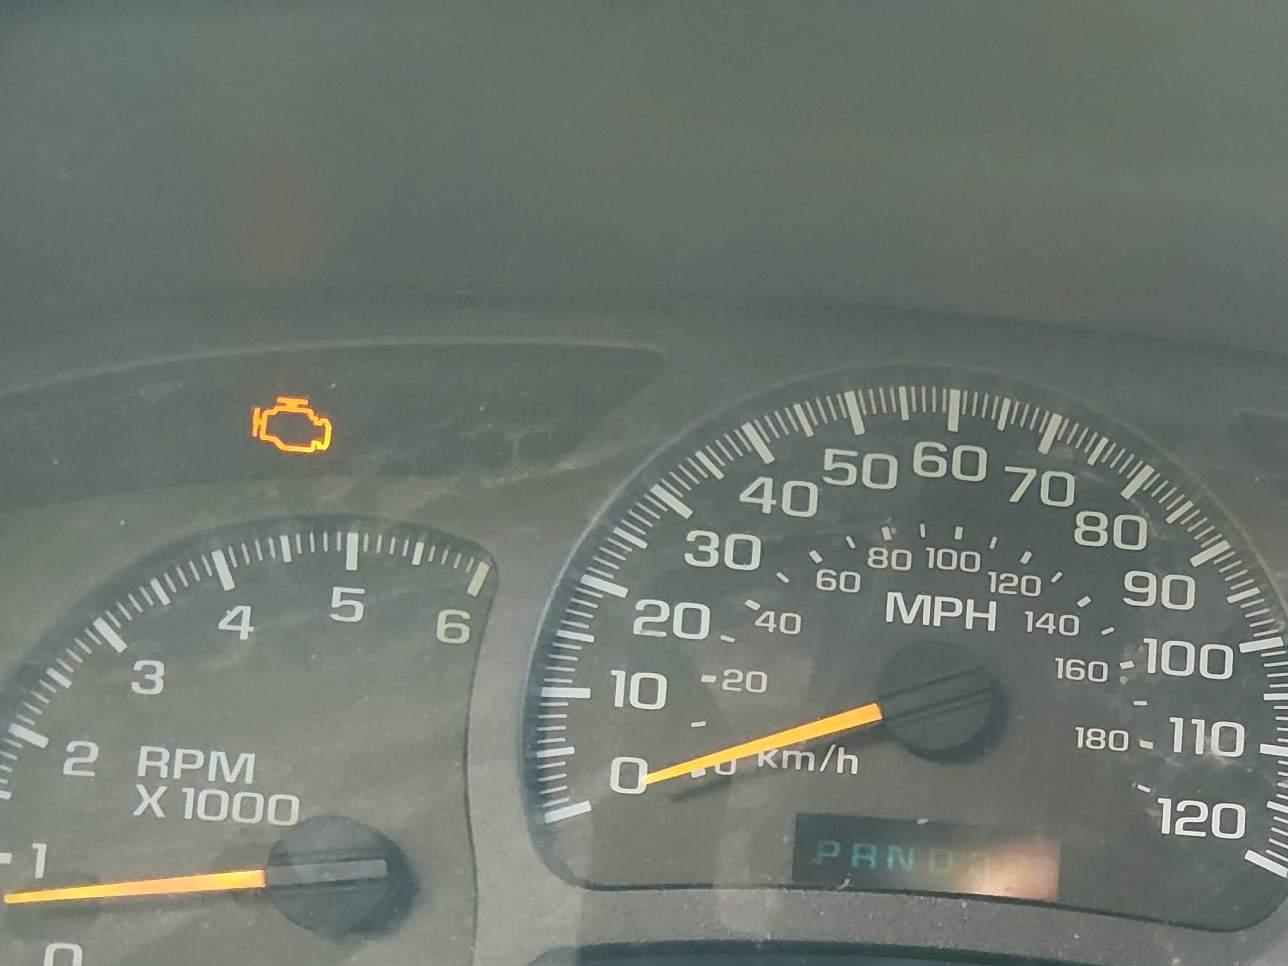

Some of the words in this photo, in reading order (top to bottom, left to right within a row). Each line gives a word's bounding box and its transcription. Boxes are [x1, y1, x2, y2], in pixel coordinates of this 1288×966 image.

[822, 448, 898, 490] 50
[912, 441, 988, 482] 60
[739, 476, 819, 518] 40
[1004, 465, 1076, 508] 70
[1074, 510, 1148, 551] 80
[684, 529, 762, 571] 30
[867, 547, 913, 571] 80
[925, 546, 981, 573] 100
[816, 568, 861, 593] 60
[988, 571, 1042, 597] 120
[1122, 570, 1196, 611] 90
[218, 605, 255, 641] 4
[329, 586, 366, 623] 5
[632, 598, 711, 640] 20
[754, 610, 802, 635] 40
[885, 591, 997, 632] MPH
[1024, 610, 1080, 636] 140
[436, 609, 471, 644] 6
[131, 659, 165, 695] 3
[1054, 657, 1109, 683] 160
[1143, 637, 1234, 680] 100
[610, 669, 668, 710] 10
[722, 668, 768, 693] 20
[1075, 726, 1129, 752] 180
[1169, 716, 1245, 758] 110
[62, 740, 99, 777] 2
[137, 745, 256, 785] RPM
[609, 756, 649, 795] 0
[757, 743, 859, 775] km/h
[133, 783, 169, 818] X
[181, 787, 300, 826] 1000
[1157, 797, 1246, 839] 120
[31, 842, 47, 879] 1
